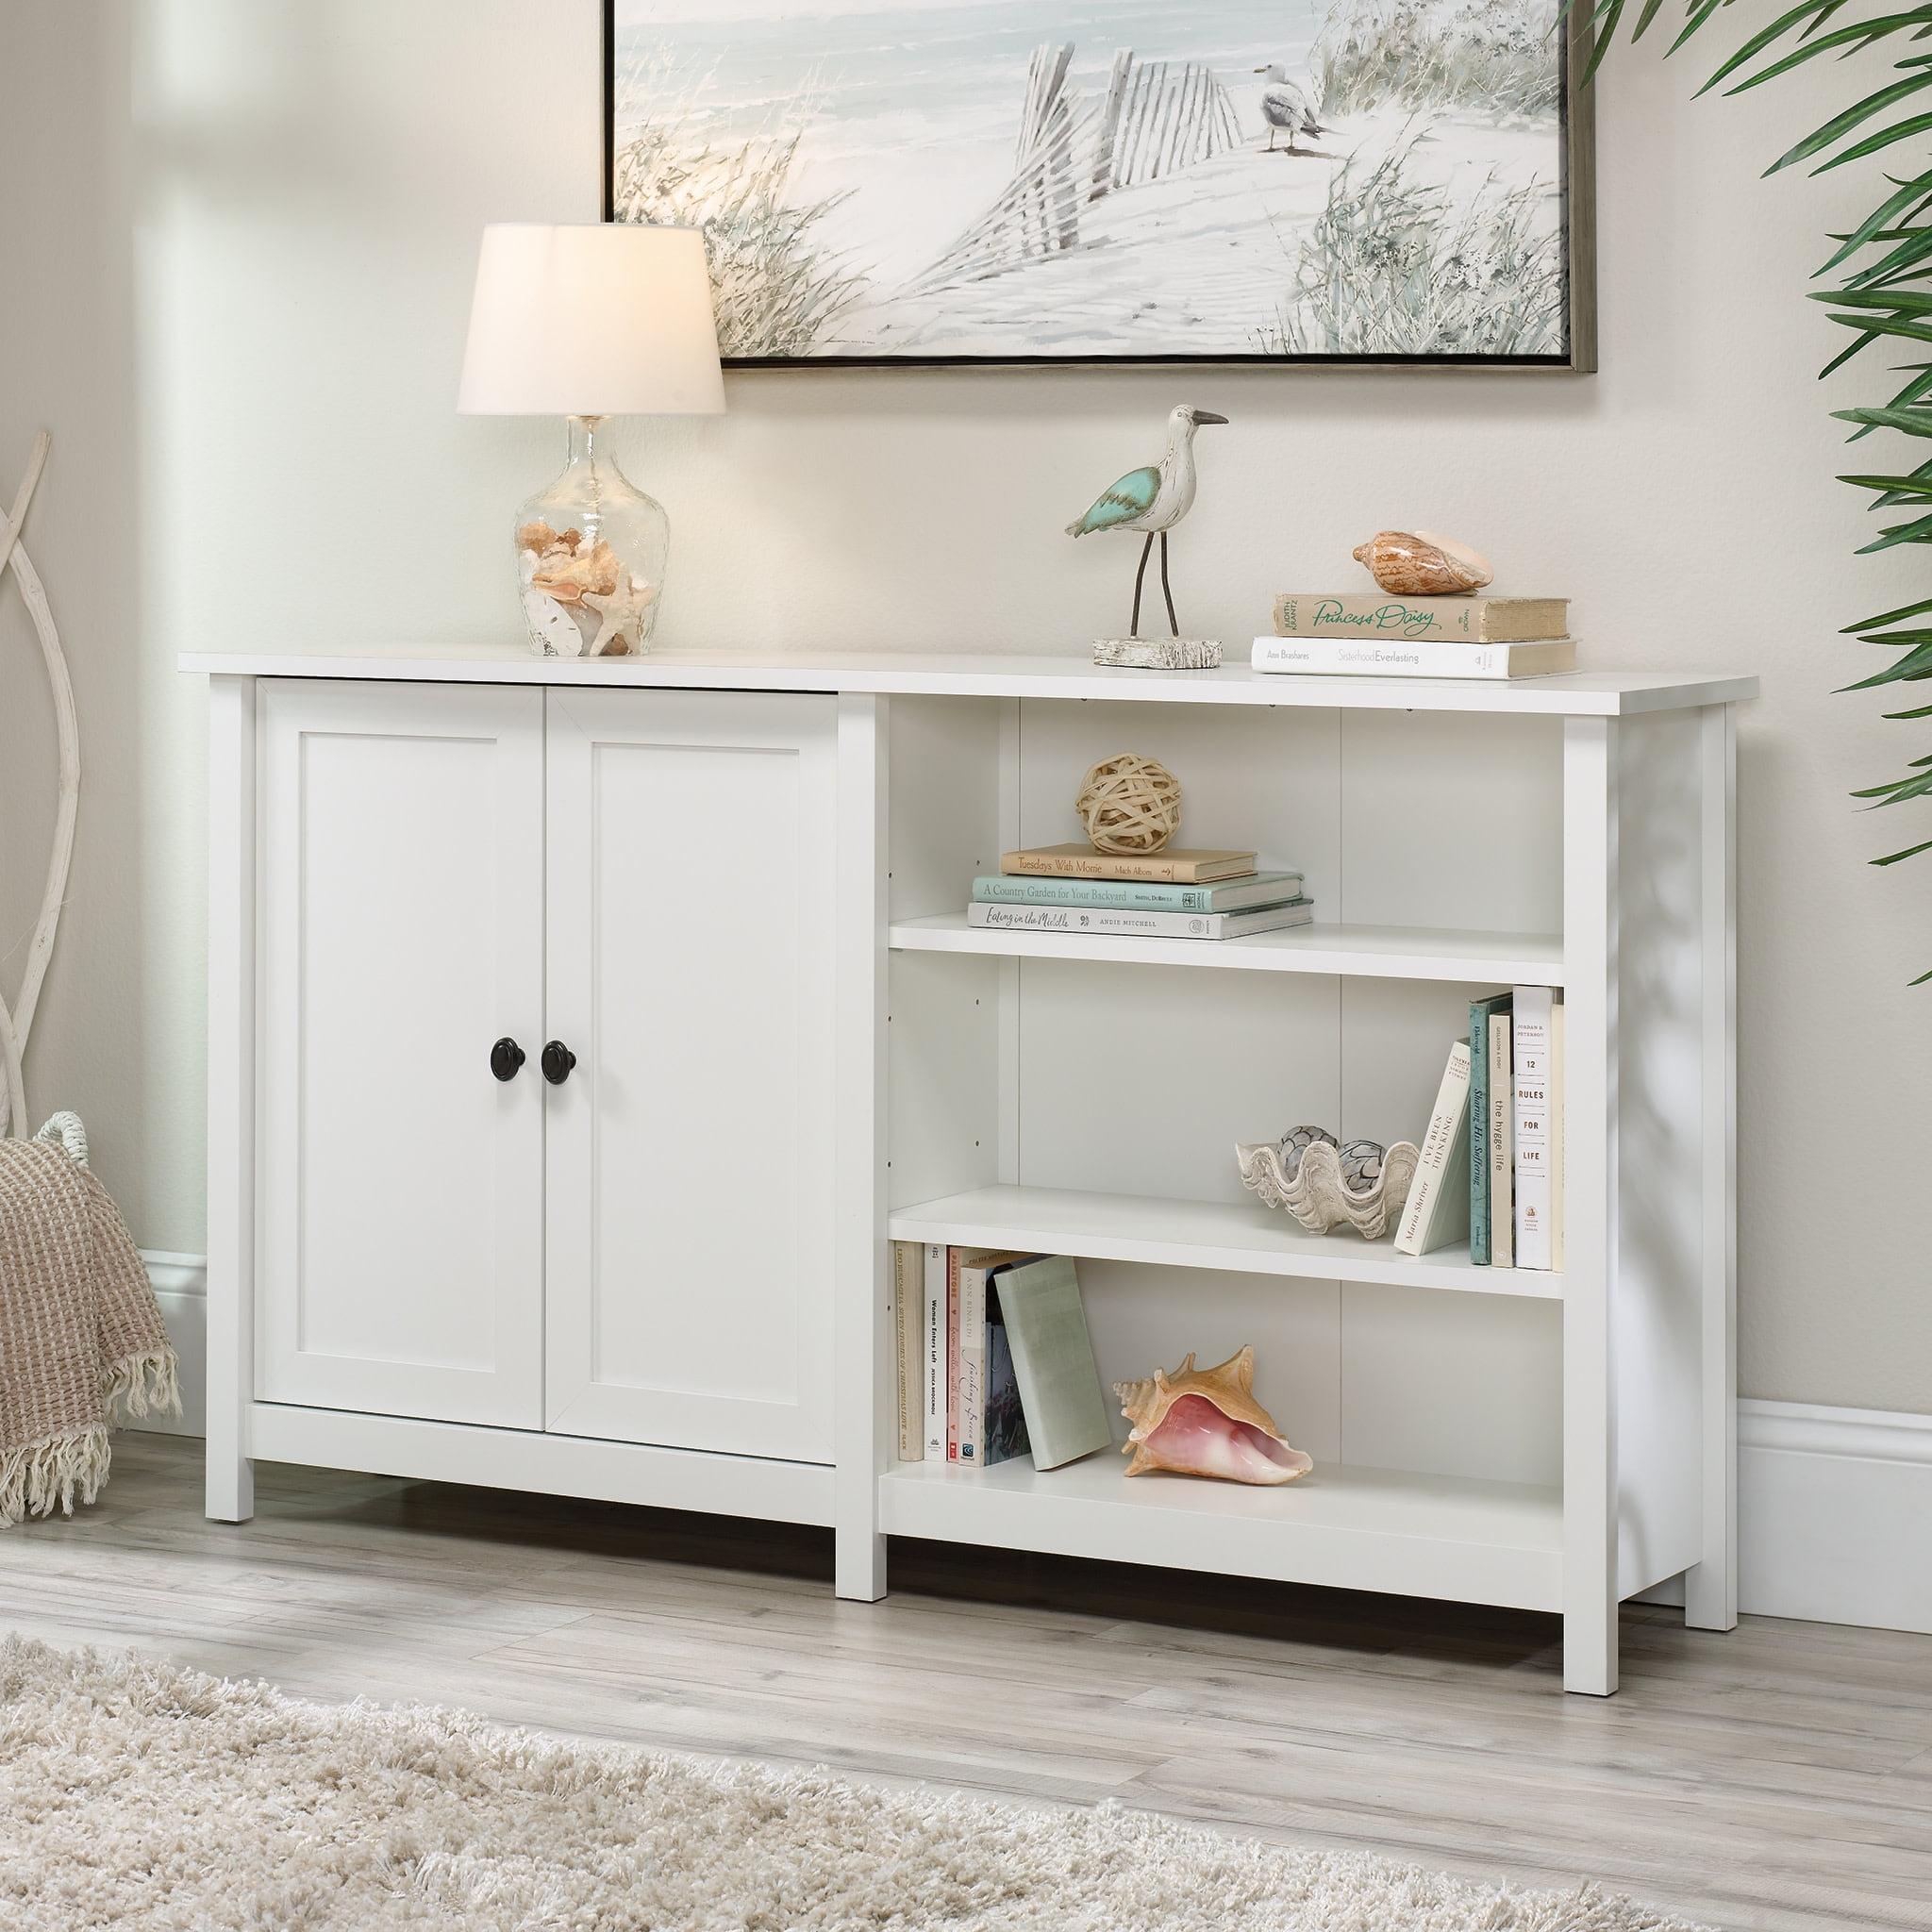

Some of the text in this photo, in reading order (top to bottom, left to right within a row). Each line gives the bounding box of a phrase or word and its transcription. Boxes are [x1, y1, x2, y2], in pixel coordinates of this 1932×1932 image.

[1290, 600, 1298, 631] KRANTZ
[1312, 599, 1442, 637] Princess Daisy
[1266, 649, 1309, 661] Ann Brashares
[1017, 857, 1103, 874] Tuesdays With Morrie
[983, 886, 1127, 903] A Country Garden for Your Backyard
[986, 907, 1070, 928] Eating in the Middle
[1099, 918, 1157, 928] ANDIE MITCHELL
[1526, 1060, 1536, 1069] 12
[1518, 1091, 1544, 1100] RULES
[1429, 1114, 1442, 1139] BEEN
[1524, 1121, 1539, 1130] FOR
[1472, 1088, 1483, 1186] Sharing His Suffering
[1493, 1119, 1504, 1151] hygge
[1494, 1153, 1504, 1172] life
[1524, 1152, 1540, 1160] LIFE
[1405, 1181, 1429, 1242] Maria Shriver
